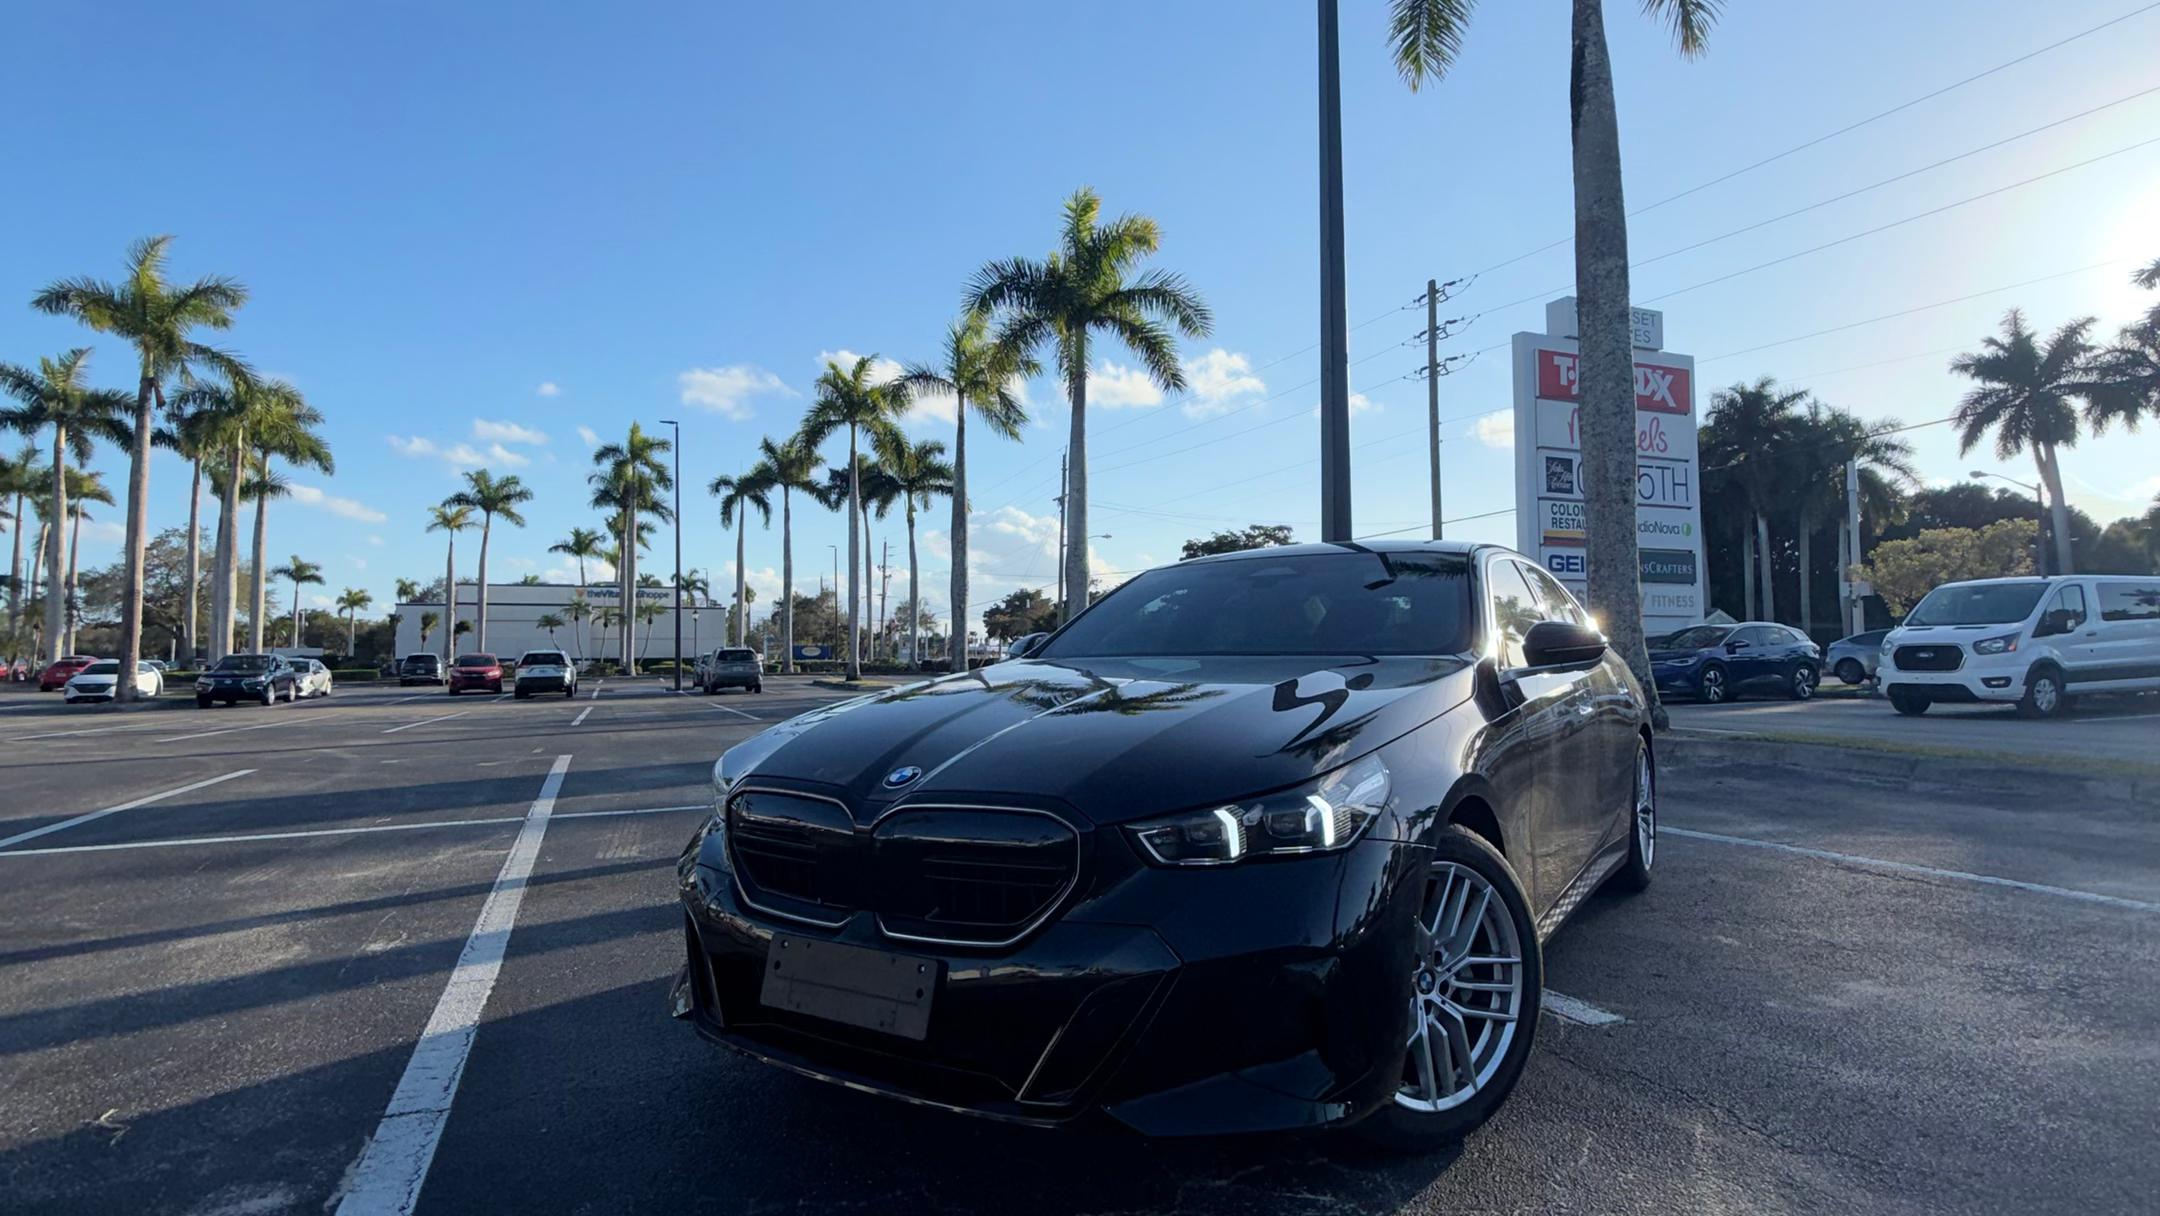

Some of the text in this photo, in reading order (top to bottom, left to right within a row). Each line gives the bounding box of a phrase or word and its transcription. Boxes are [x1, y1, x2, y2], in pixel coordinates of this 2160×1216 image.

[1632, 311, 1656, 327] SET
[1631, 329, 1651, 343] ES
[1637, 465, 1689, 502] 5TH
[1549, 554, 1585, 573] GEI
